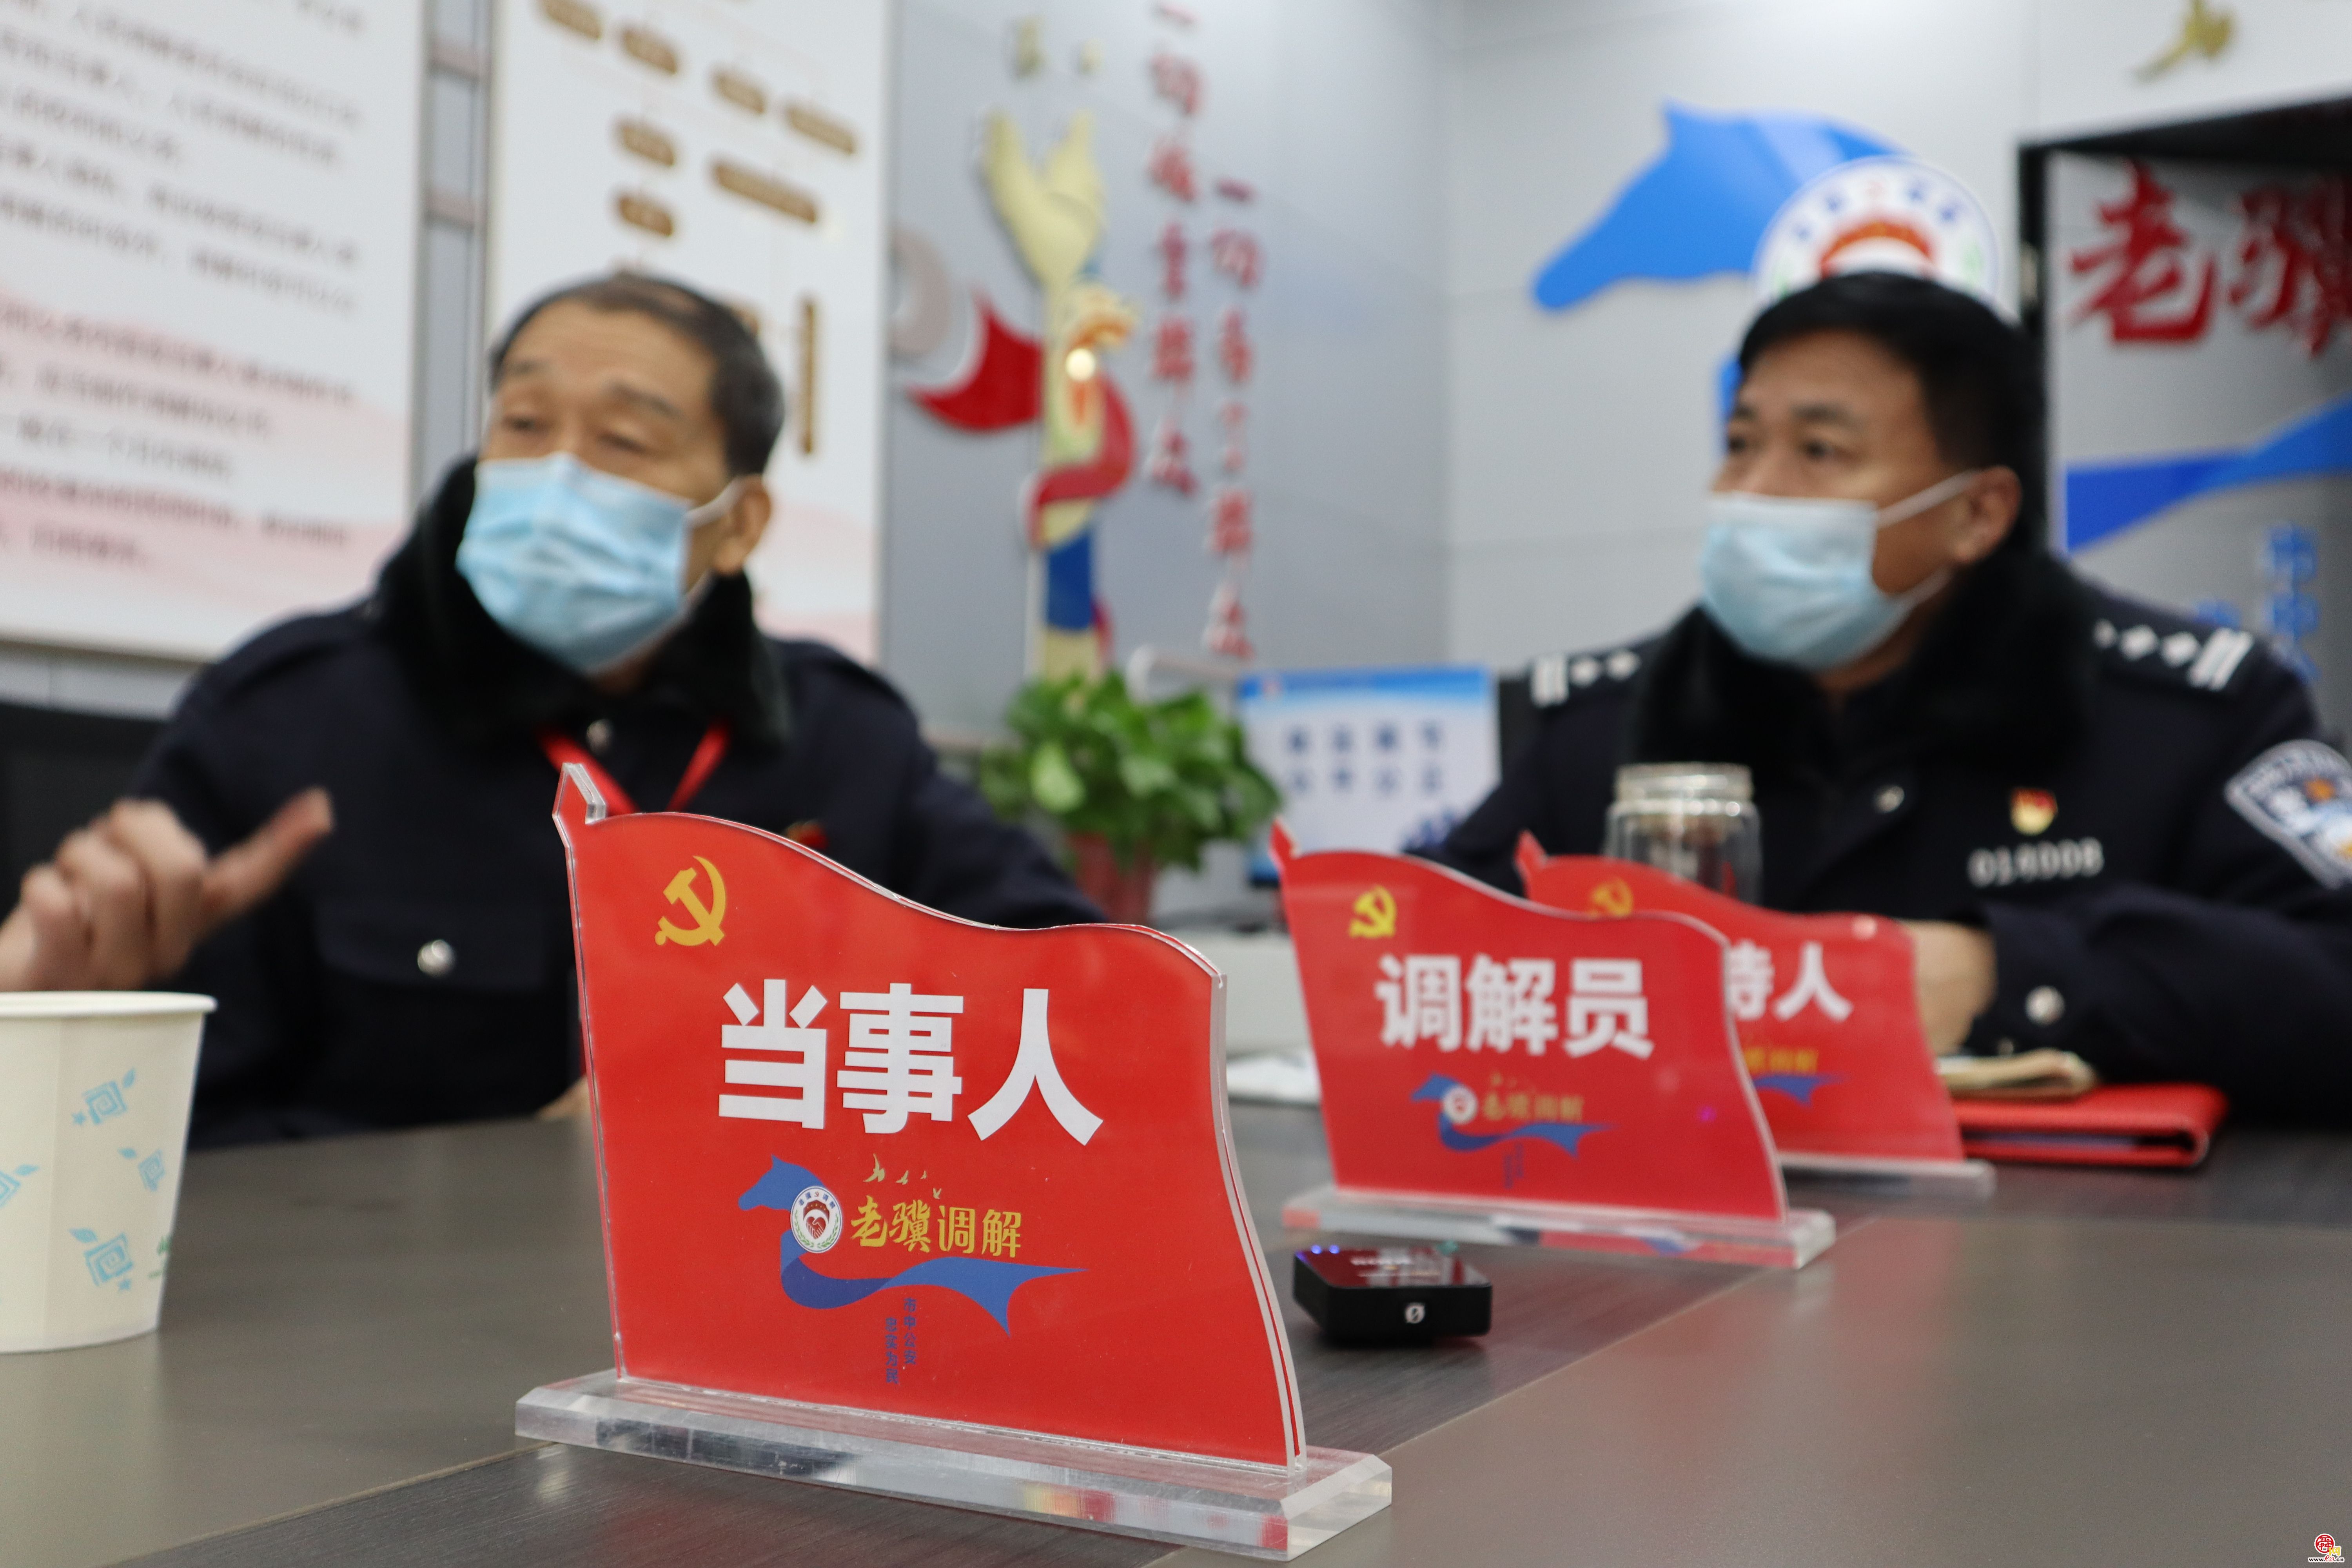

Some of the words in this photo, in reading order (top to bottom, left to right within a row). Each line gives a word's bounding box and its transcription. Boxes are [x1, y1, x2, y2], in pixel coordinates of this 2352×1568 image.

[1374, 953, 1655, 1060] 调解员
[718, 978, 1104, 1146] 当事人
[851, 1196, 1022, 1258] 老骥调解
[885, 1317, 899, 1384] 忠实为民
[903, 1297, 916, 1365] 市中公安
